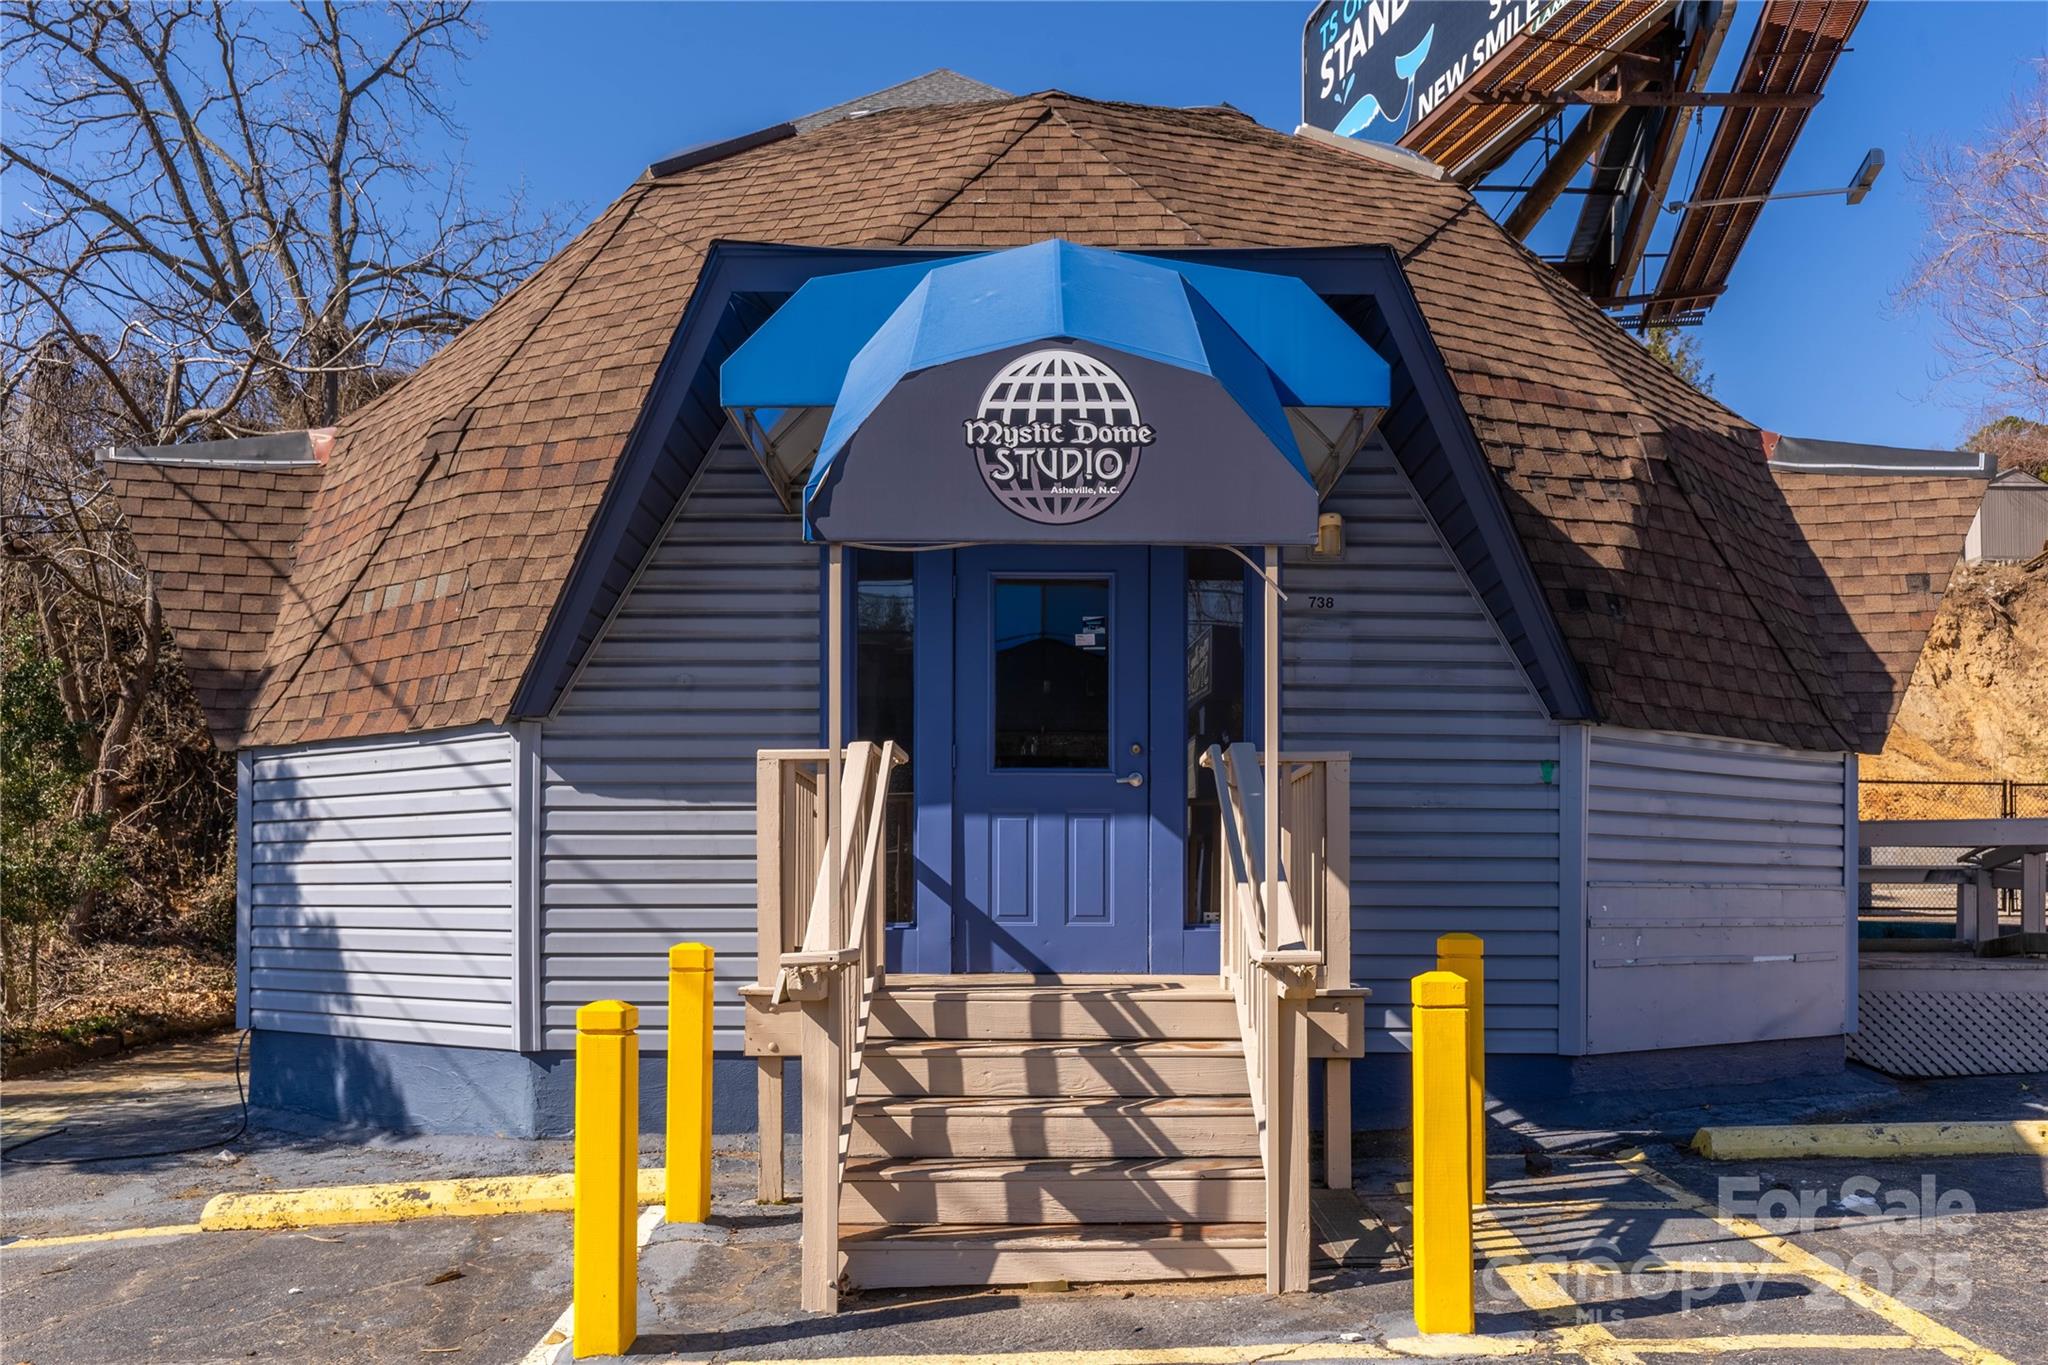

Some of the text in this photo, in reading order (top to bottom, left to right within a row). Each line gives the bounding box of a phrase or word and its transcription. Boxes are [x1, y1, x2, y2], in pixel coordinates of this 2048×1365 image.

[1535, 0, 1570, 30] LAM
[1418, 54, 1468, 122] NEW
[964, 418, 1153, 449] Mystic Dome
[1050, 486, 1120, 495] Asheville, N.C.
[1308, 596, 1335, 609] 738
